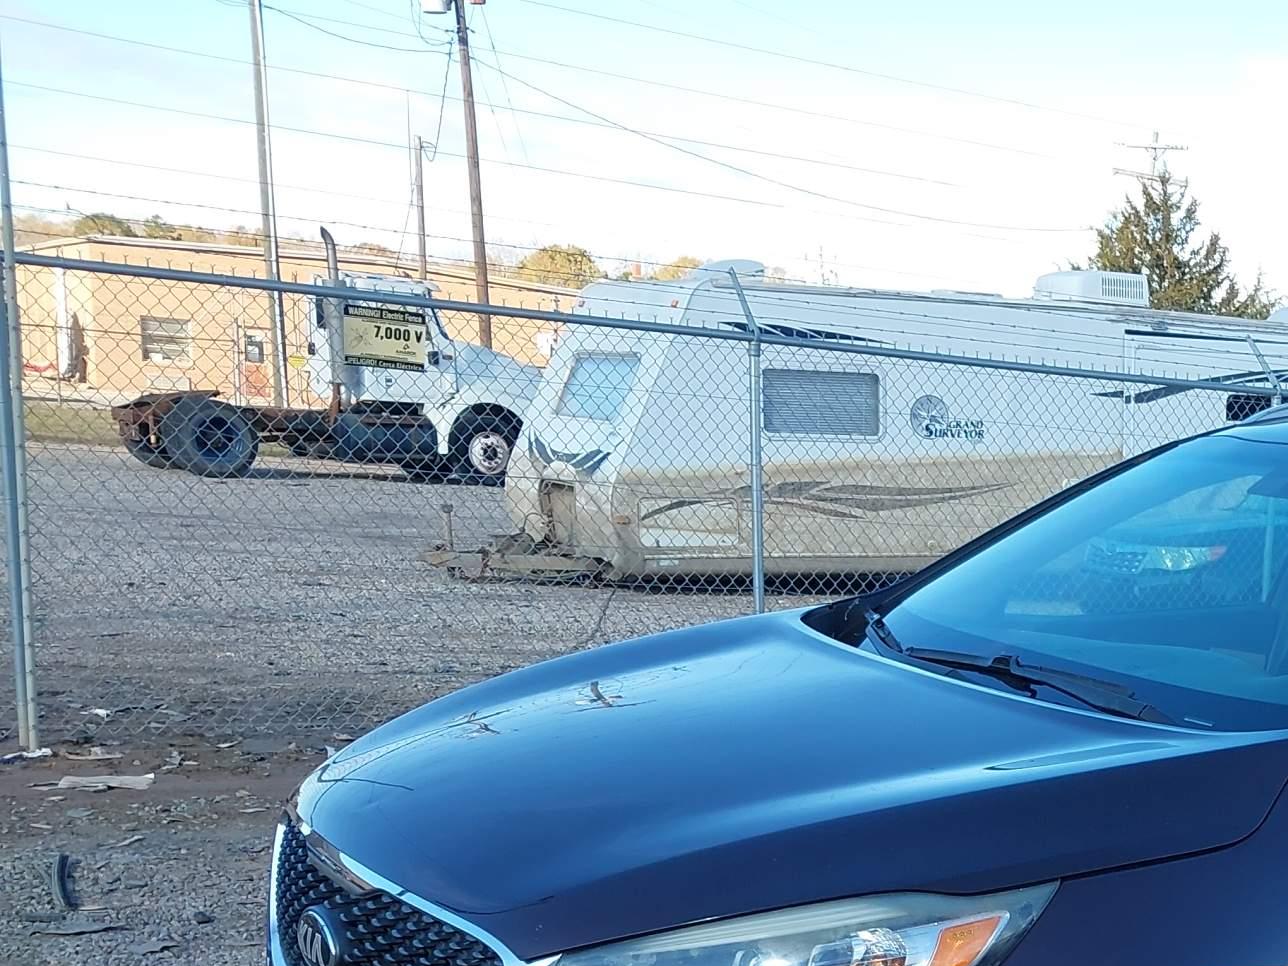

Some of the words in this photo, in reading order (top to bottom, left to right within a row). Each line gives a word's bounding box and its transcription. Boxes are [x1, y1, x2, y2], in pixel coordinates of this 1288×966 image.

[348, 306, 380, 318] WARNING!
[382, 310, 404, 320] Electric
[404, 313, 422, 323] Fence
[374, 325, 411, 341] 7,000
[414, 330, 423, 343] V
[924, 423, 985, 439] SURVEYOR
[949, 420, 984, 429] GRAND
